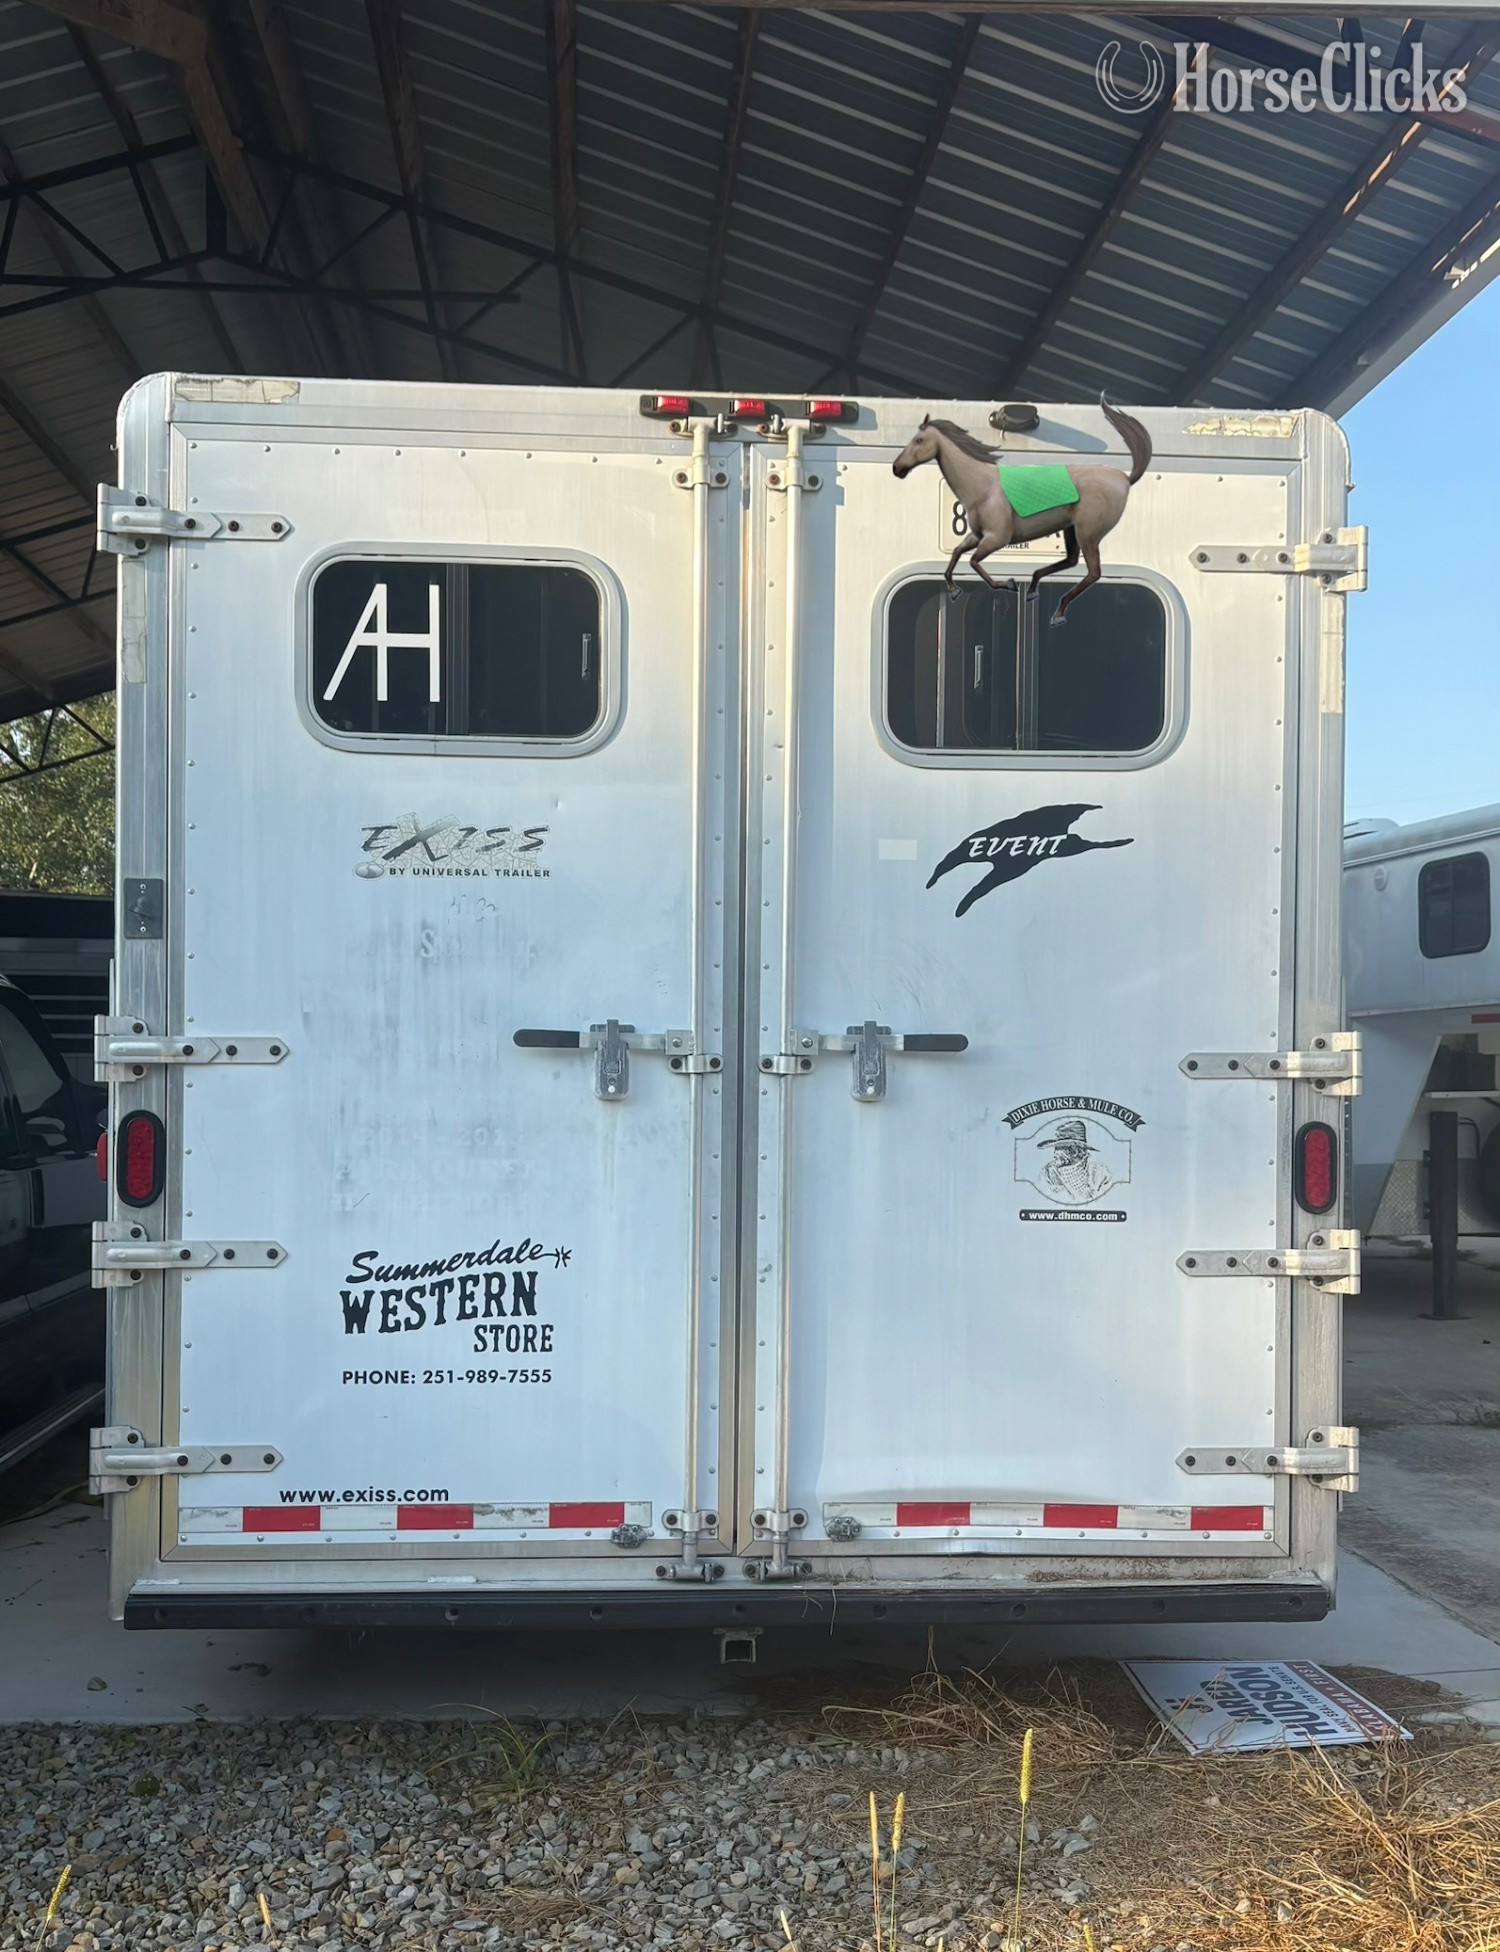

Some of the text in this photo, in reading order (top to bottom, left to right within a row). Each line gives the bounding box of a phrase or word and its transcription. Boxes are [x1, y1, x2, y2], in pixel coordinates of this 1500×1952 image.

[322, 583, 440, 702] AH
[969, 834, 1067, 858] EVENT
[389, 868, 550, 878] BY UNIVERSAL TRAILER
[1011, 1097, 1134, 1124] DIXIE HORSE & MULE CO.
[1028, 1211, 1118, 1221] www.dhmco.com
[345, 1238, 546, 1284] Summerdale
[339, 1271, 539, 1334] WESTERN
[473, 1324, 554, 1353] STORE
[342, 1369, 552, 1384] PHONE: 251-989-7555
[279, 1486, 449, 1503] www.exiss.com
[1268, 1666, 1297, 1685] SENATE
[1292, 1664, 1329, 1684] FIRST
[1200, 1680, 1274, 1725] JARED
[1224, 1666, 1339, 1737] HUDSON
[1302, 1695, 1323, 1704] FOR
[1316, 1704, 1339, 1717] SEAL
